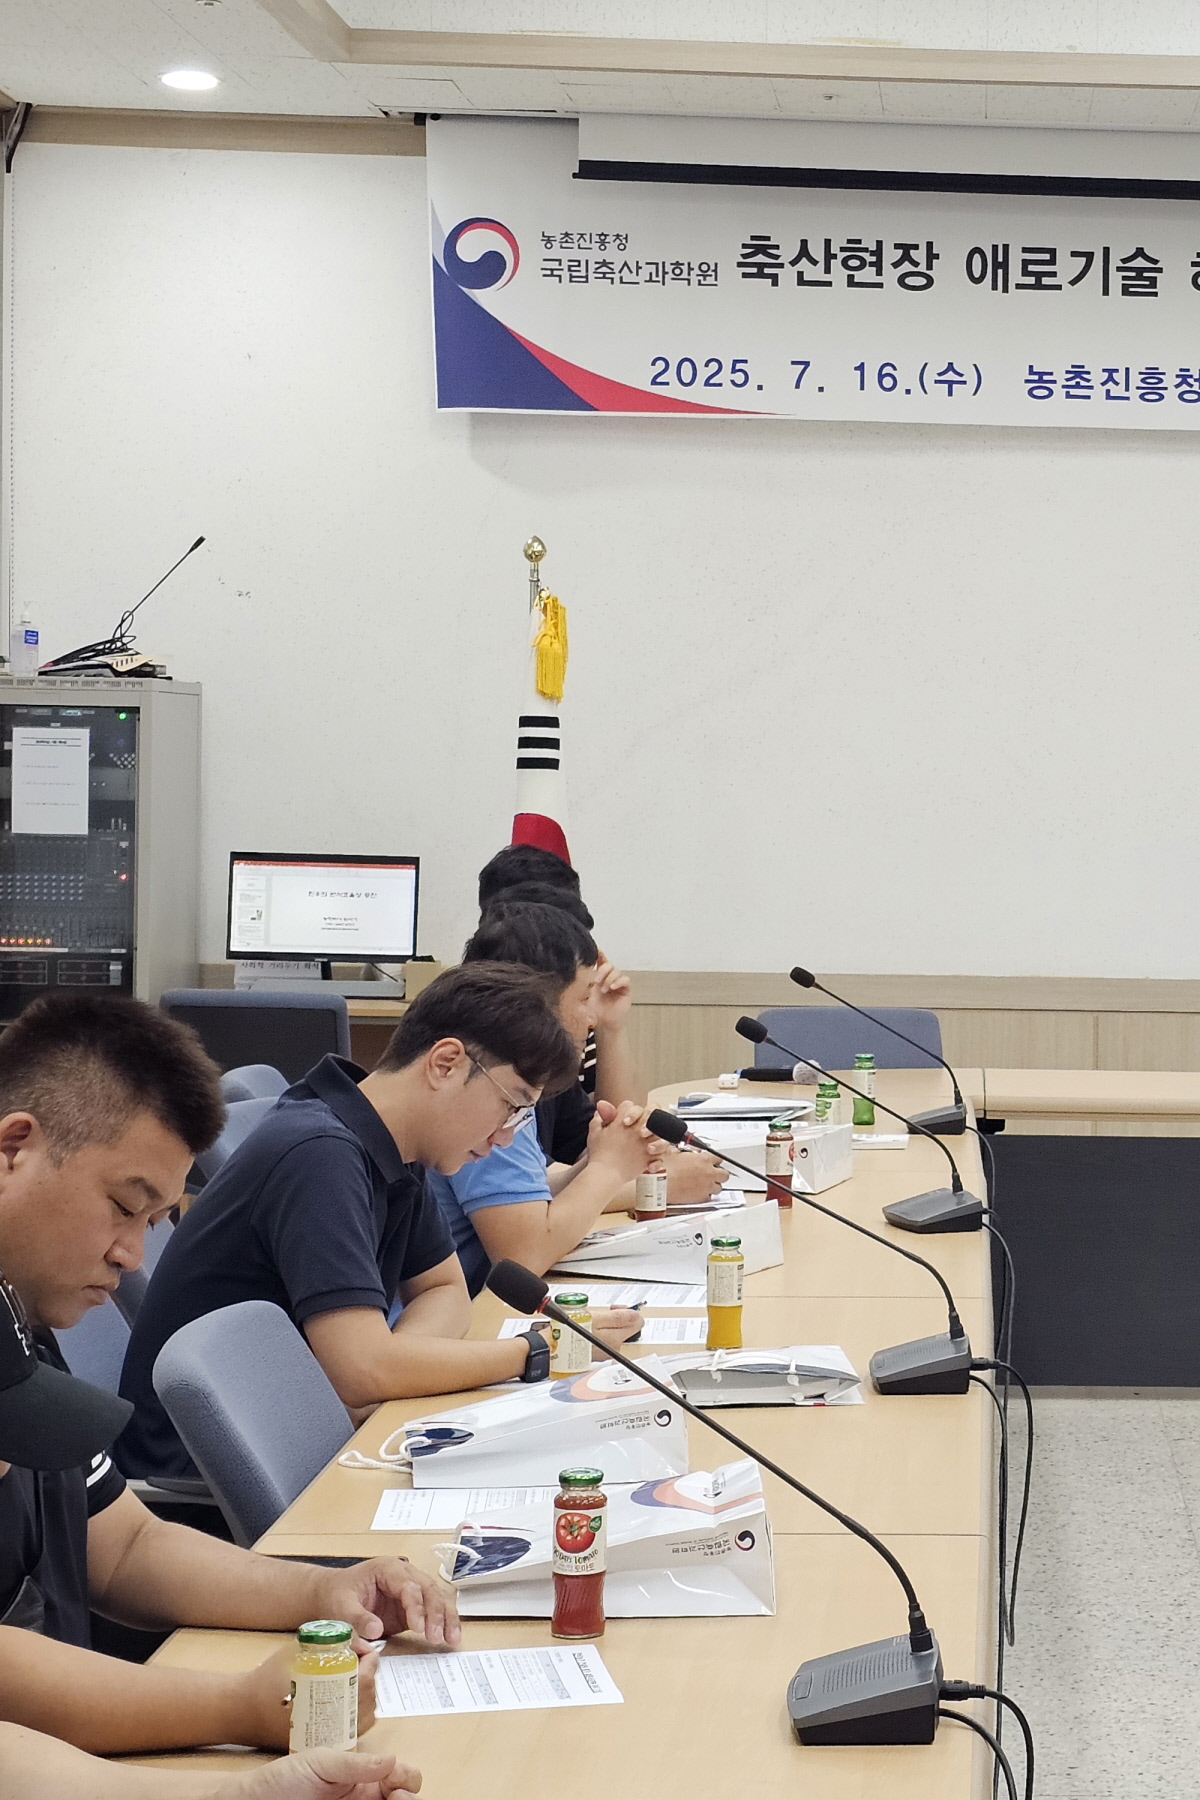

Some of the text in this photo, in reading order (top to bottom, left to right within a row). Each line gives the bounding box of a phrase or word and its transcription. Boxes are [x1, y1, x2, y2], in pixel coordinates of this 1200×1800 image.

[540, 230, 629, 252] 농촌진흥청
[540, 258, 719, 287] 국립축산과학원
[736, 234, 940, 292] 축산현장
[965, 243, 1164, 298] 애로기술
[649, 356, 764, 392] 2025.
[790, 360, 825, 393] 7.
[853, 361, 983, 397] 16.(수)
